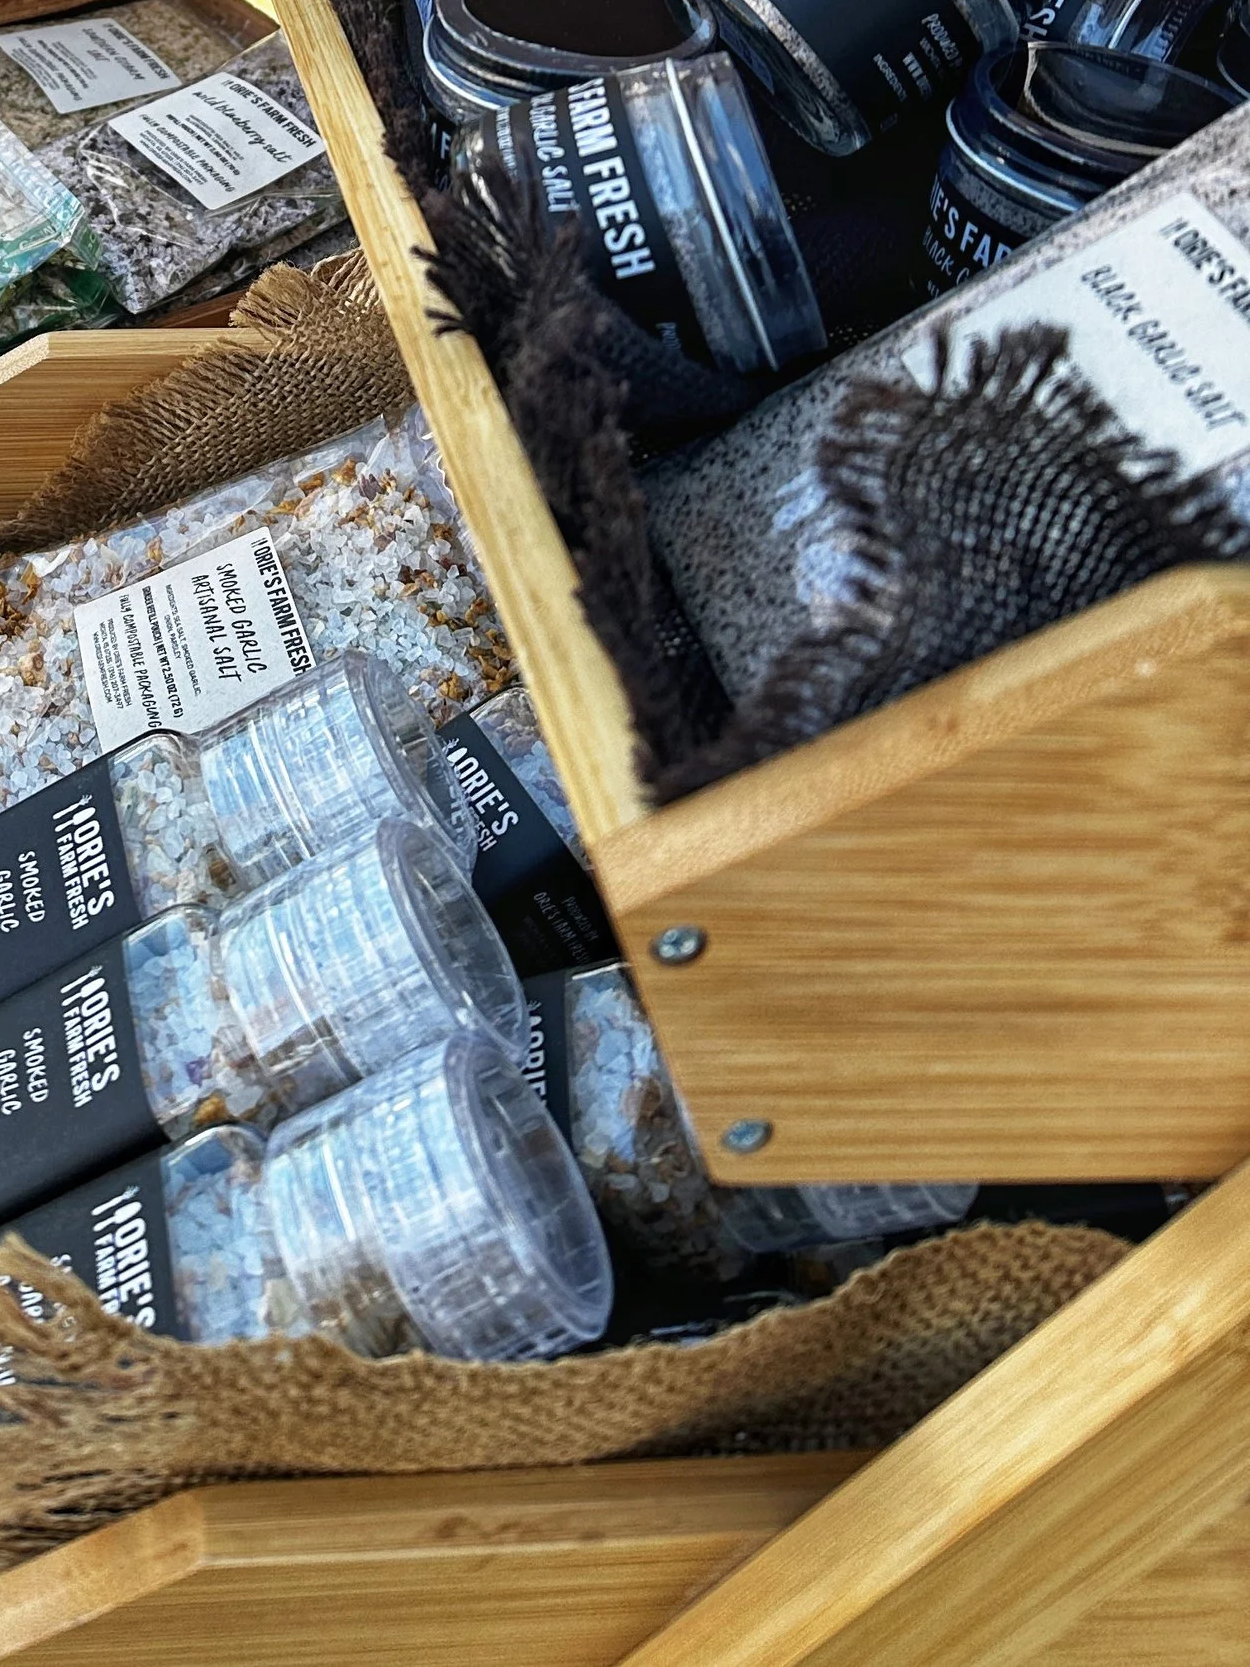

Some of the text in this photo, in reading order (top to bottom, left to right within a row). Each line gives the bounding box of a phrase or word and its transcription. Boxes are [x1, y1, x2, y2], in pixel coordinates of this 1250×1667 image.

[215, 100, 293, 164] blueberry salt
[229, 83, 317, 148] ORIE'S FARM FRESH
[195, 156, 236, 193] PACKAGING
[542, 164, 582, 214] SALT
[568, 90, 656, 280] FARM FRESH
[1173, 229, 1236, 286] ORIE'S
[1081, 264, 1248, 432] BLACK GARLIC SALT
[191, 574, 243, 682] ARTISANAL SALT
[216, 563, 267, 673] SMOKED GARLIC
[253, 546, 312, 677] ORIE'S FARM FRESH
[123, 615, 163, 728] COMPOSTABLE PACKAGING
[455, 756, 519, 836] ORIE'S
[18, 850, 46, 923] SMOKED
[57, 832, 89, 930] FARM FRESH
[74, 819, 115, 916] ORIE'S
[22, 1026, 49, 1105] SMOKED
[62, 1004, 93, 1108] FARM FRESH
[82, 989, 121, 1092] ORIE'S
[94, 1232, 119, 1292] FARM
[114, 1217, 156, 1329] ORIE'S
